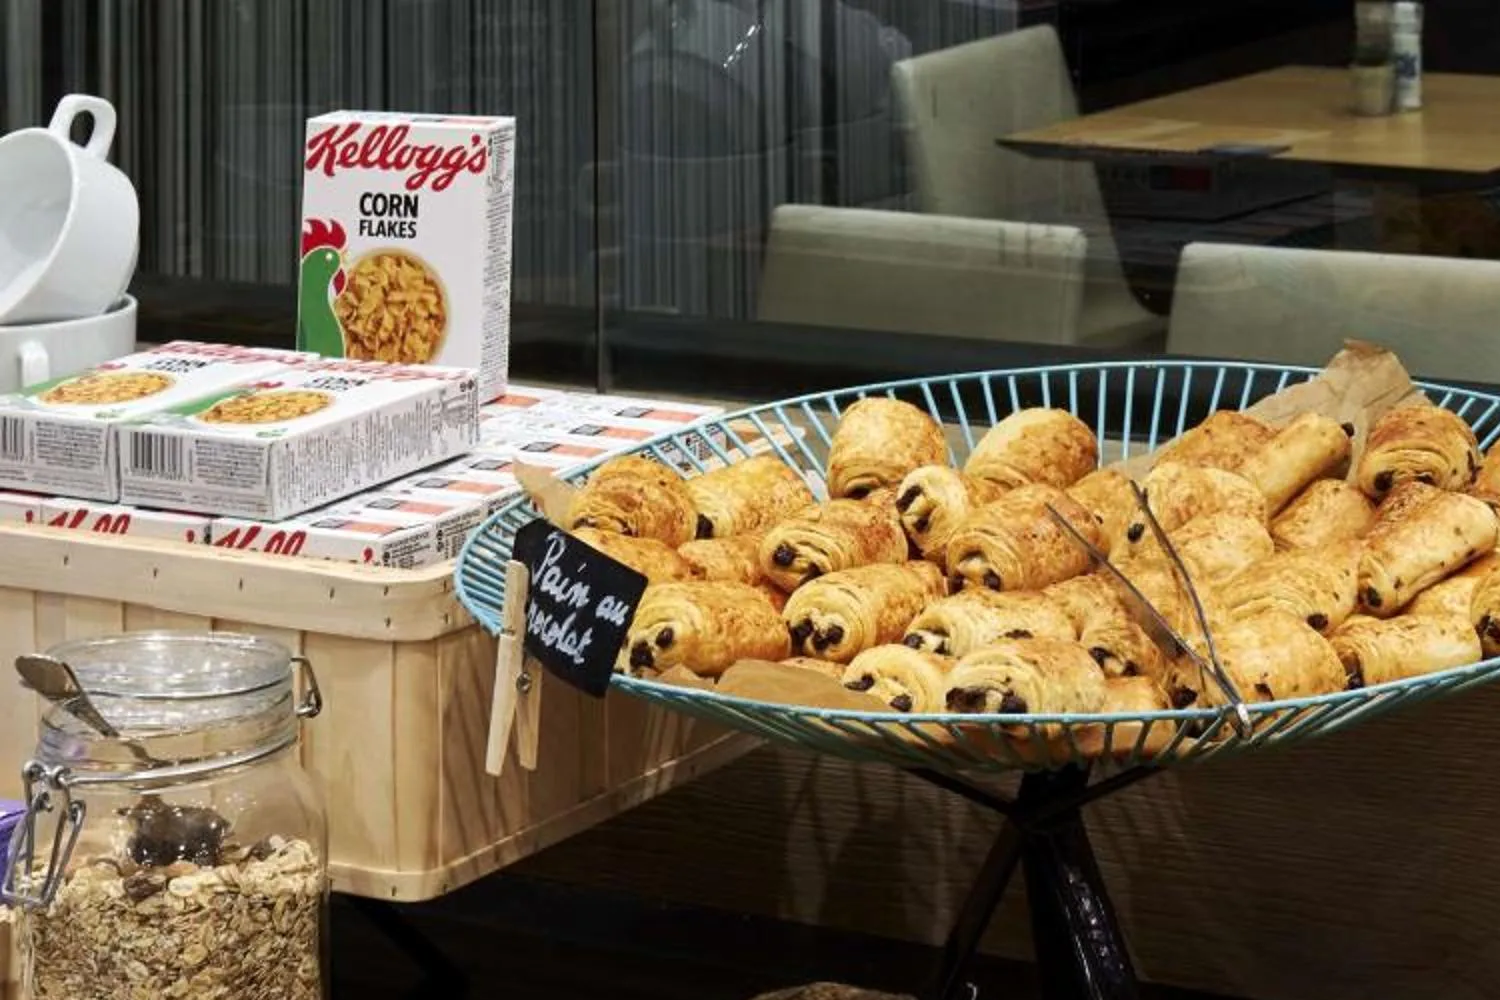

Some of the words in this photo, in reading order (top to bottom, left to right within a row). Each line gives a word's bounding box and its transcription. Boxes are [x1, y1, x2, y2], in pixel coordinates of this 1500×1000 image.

[305, 123, 487, 192] Kellogg's
[359, 192, 419, 218] CORN
[359, 219, 417, 239] FLAKES
[531, 531, 591, 608] Pain
[595, 595, 630, 627] au
